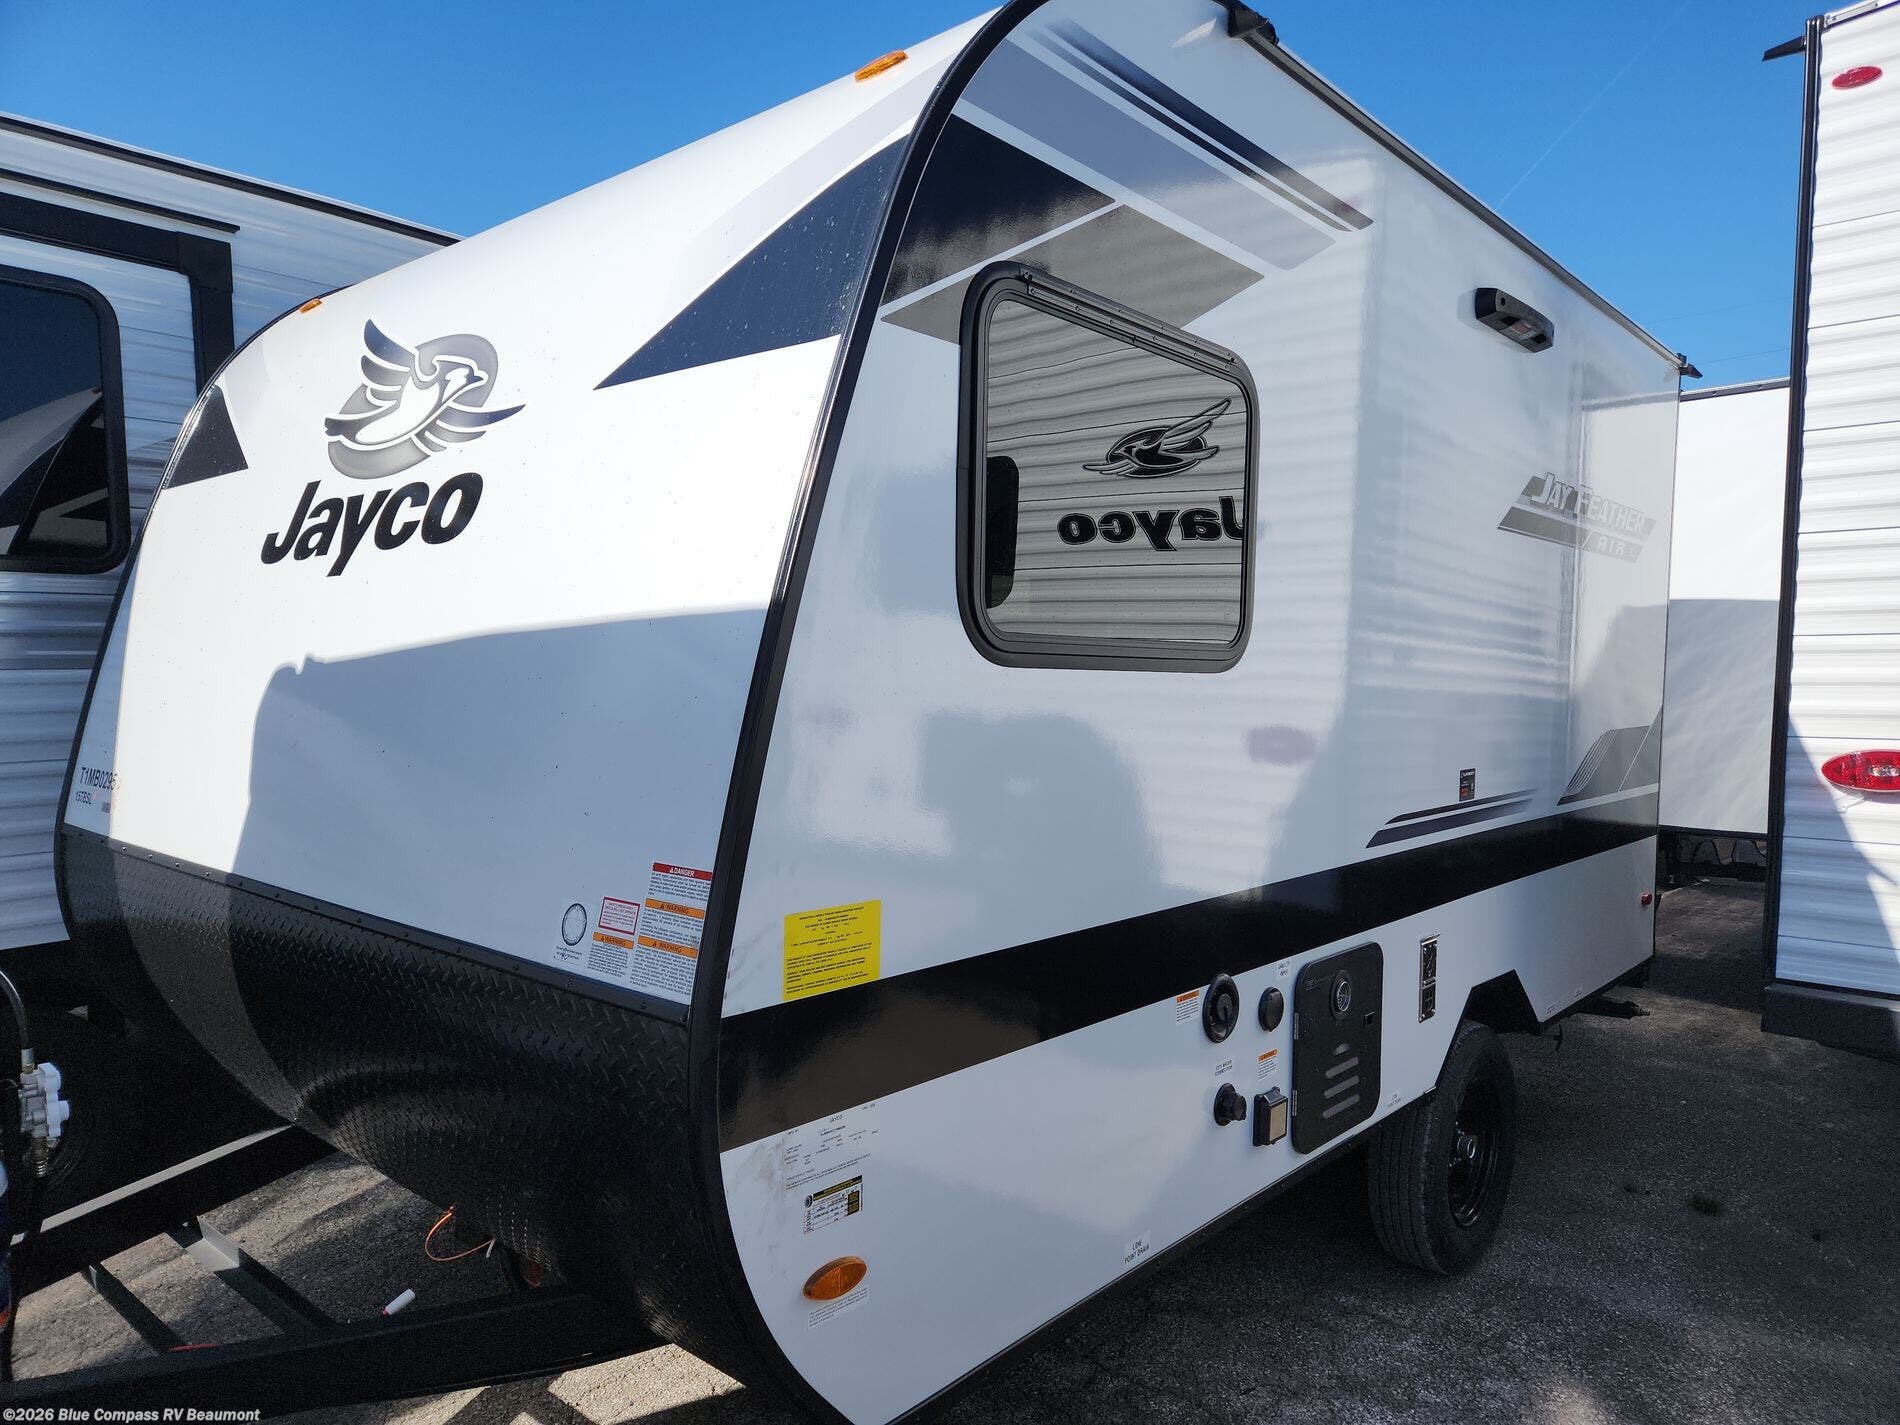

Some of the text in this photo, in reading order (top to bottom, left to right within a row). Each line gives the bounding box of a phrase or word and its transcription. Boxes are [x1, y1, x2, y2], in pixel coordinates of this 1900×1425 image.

[1530, 472, 1646, 534] JAY FEATHER
[260, 472, 484, 577] Jayco
[673, 867, 695, 878] DANGER
[664, 903, 689, 915] WARNING
